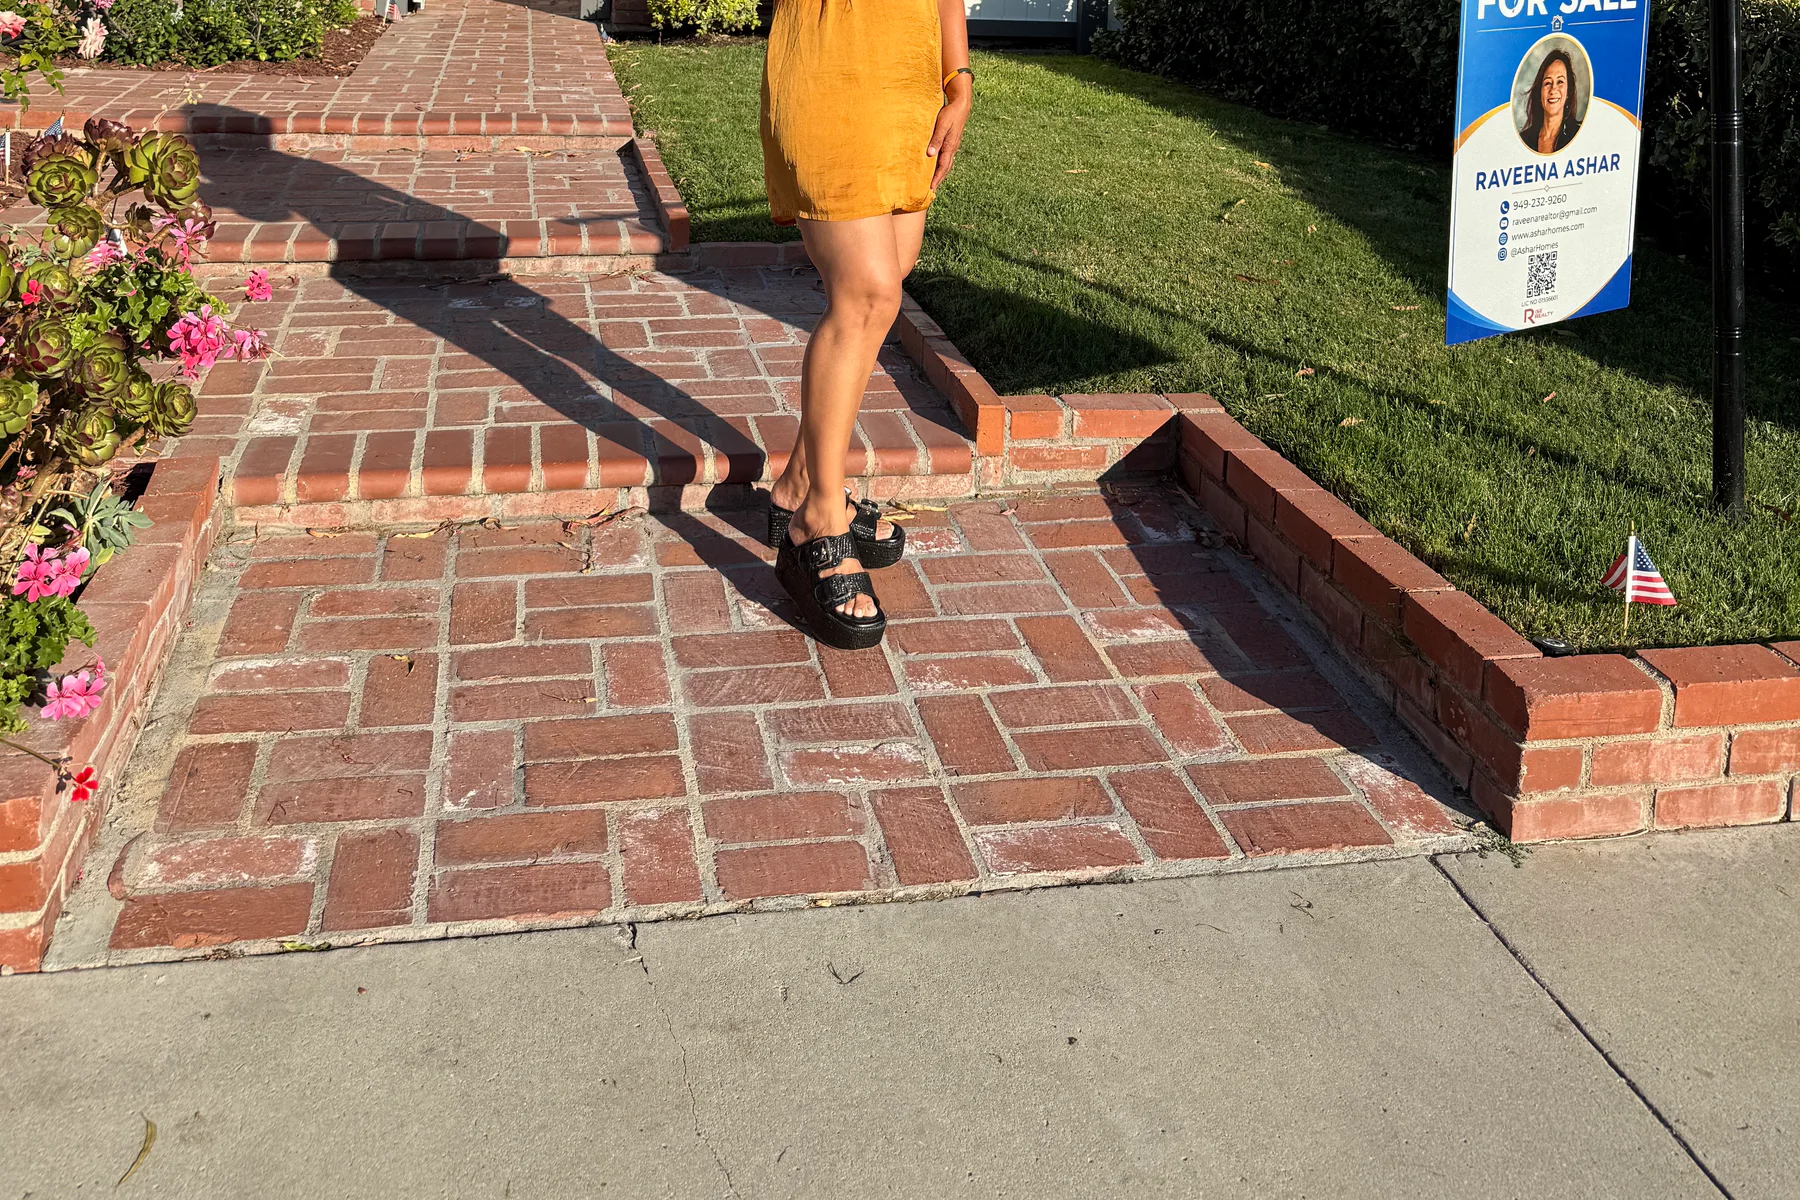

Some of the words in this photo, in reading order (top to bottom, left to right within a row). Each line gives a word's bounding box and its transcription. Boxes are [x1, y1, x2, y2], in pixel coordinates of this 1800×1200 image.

[1475, 162, 1559, 191] RAVEENA
[1563, 153, 1621, 178] ASHAR
[1513, 194, 1567, 210] 949-232-9260
[1512, 206, 1597, 226] raveenarealtor@gmail.com
[1511, 222, 1584, 240] www.asharhomes.com
[1510, 241, 1558, 258] @AsharHomes
